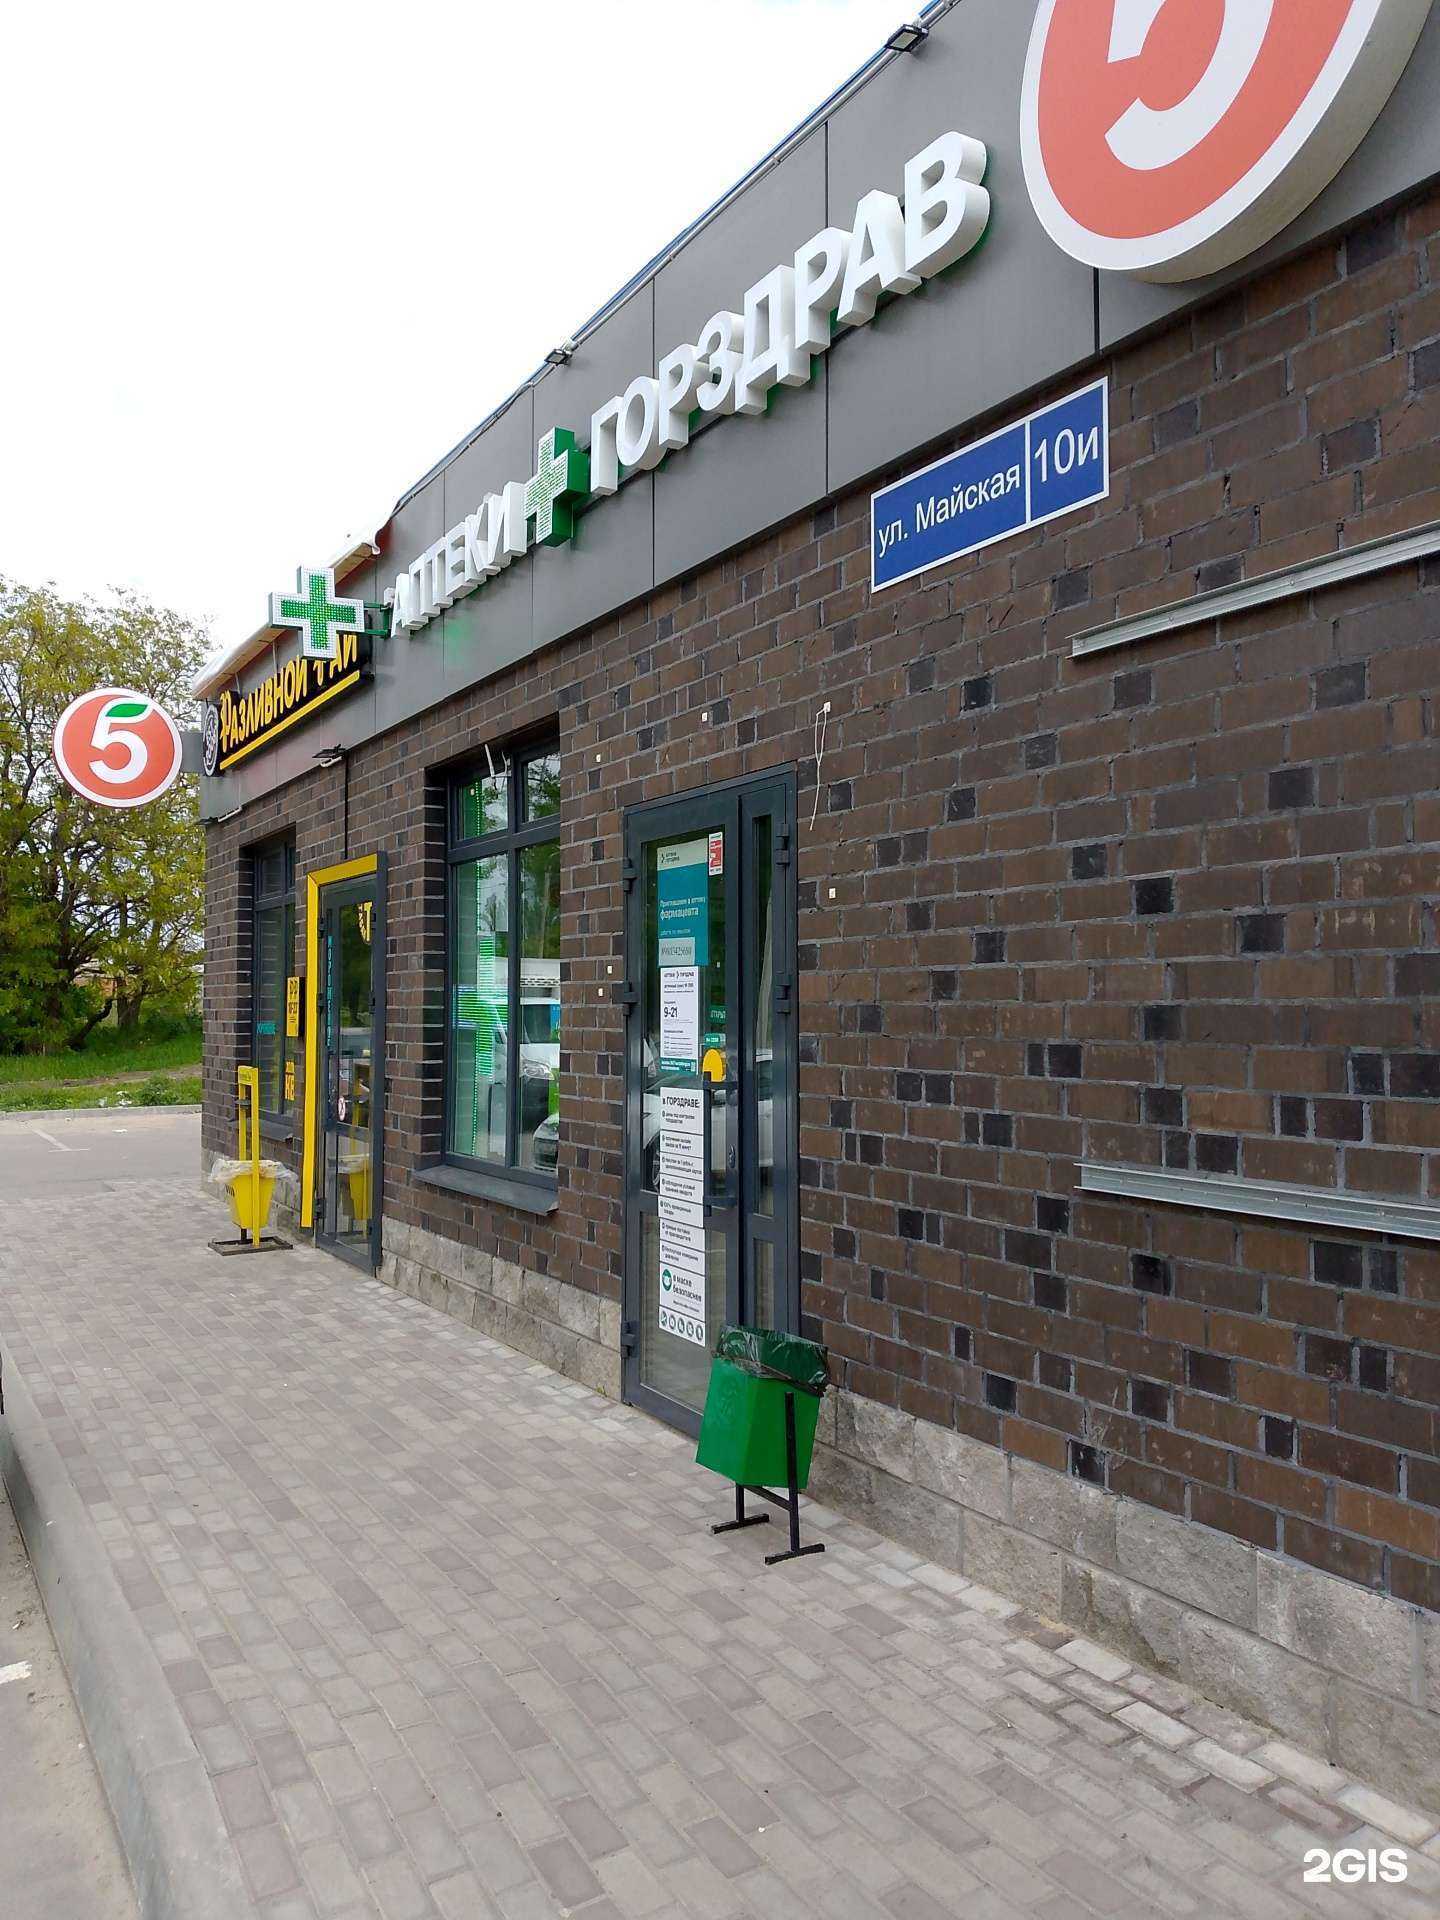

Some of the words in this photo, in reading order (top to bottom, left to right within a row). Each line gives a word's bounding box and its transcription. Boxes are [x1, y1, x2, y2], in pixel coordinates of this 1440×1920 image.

[390, 480, 528, 638] АПТЕКИ
[590, 131, 990, 496] ГОРЗДРАВ
[877, 513, 908, 557] ул.
[914, 462, 1021, 534] Майская
[1033, 424, 1099, 484] 10и
